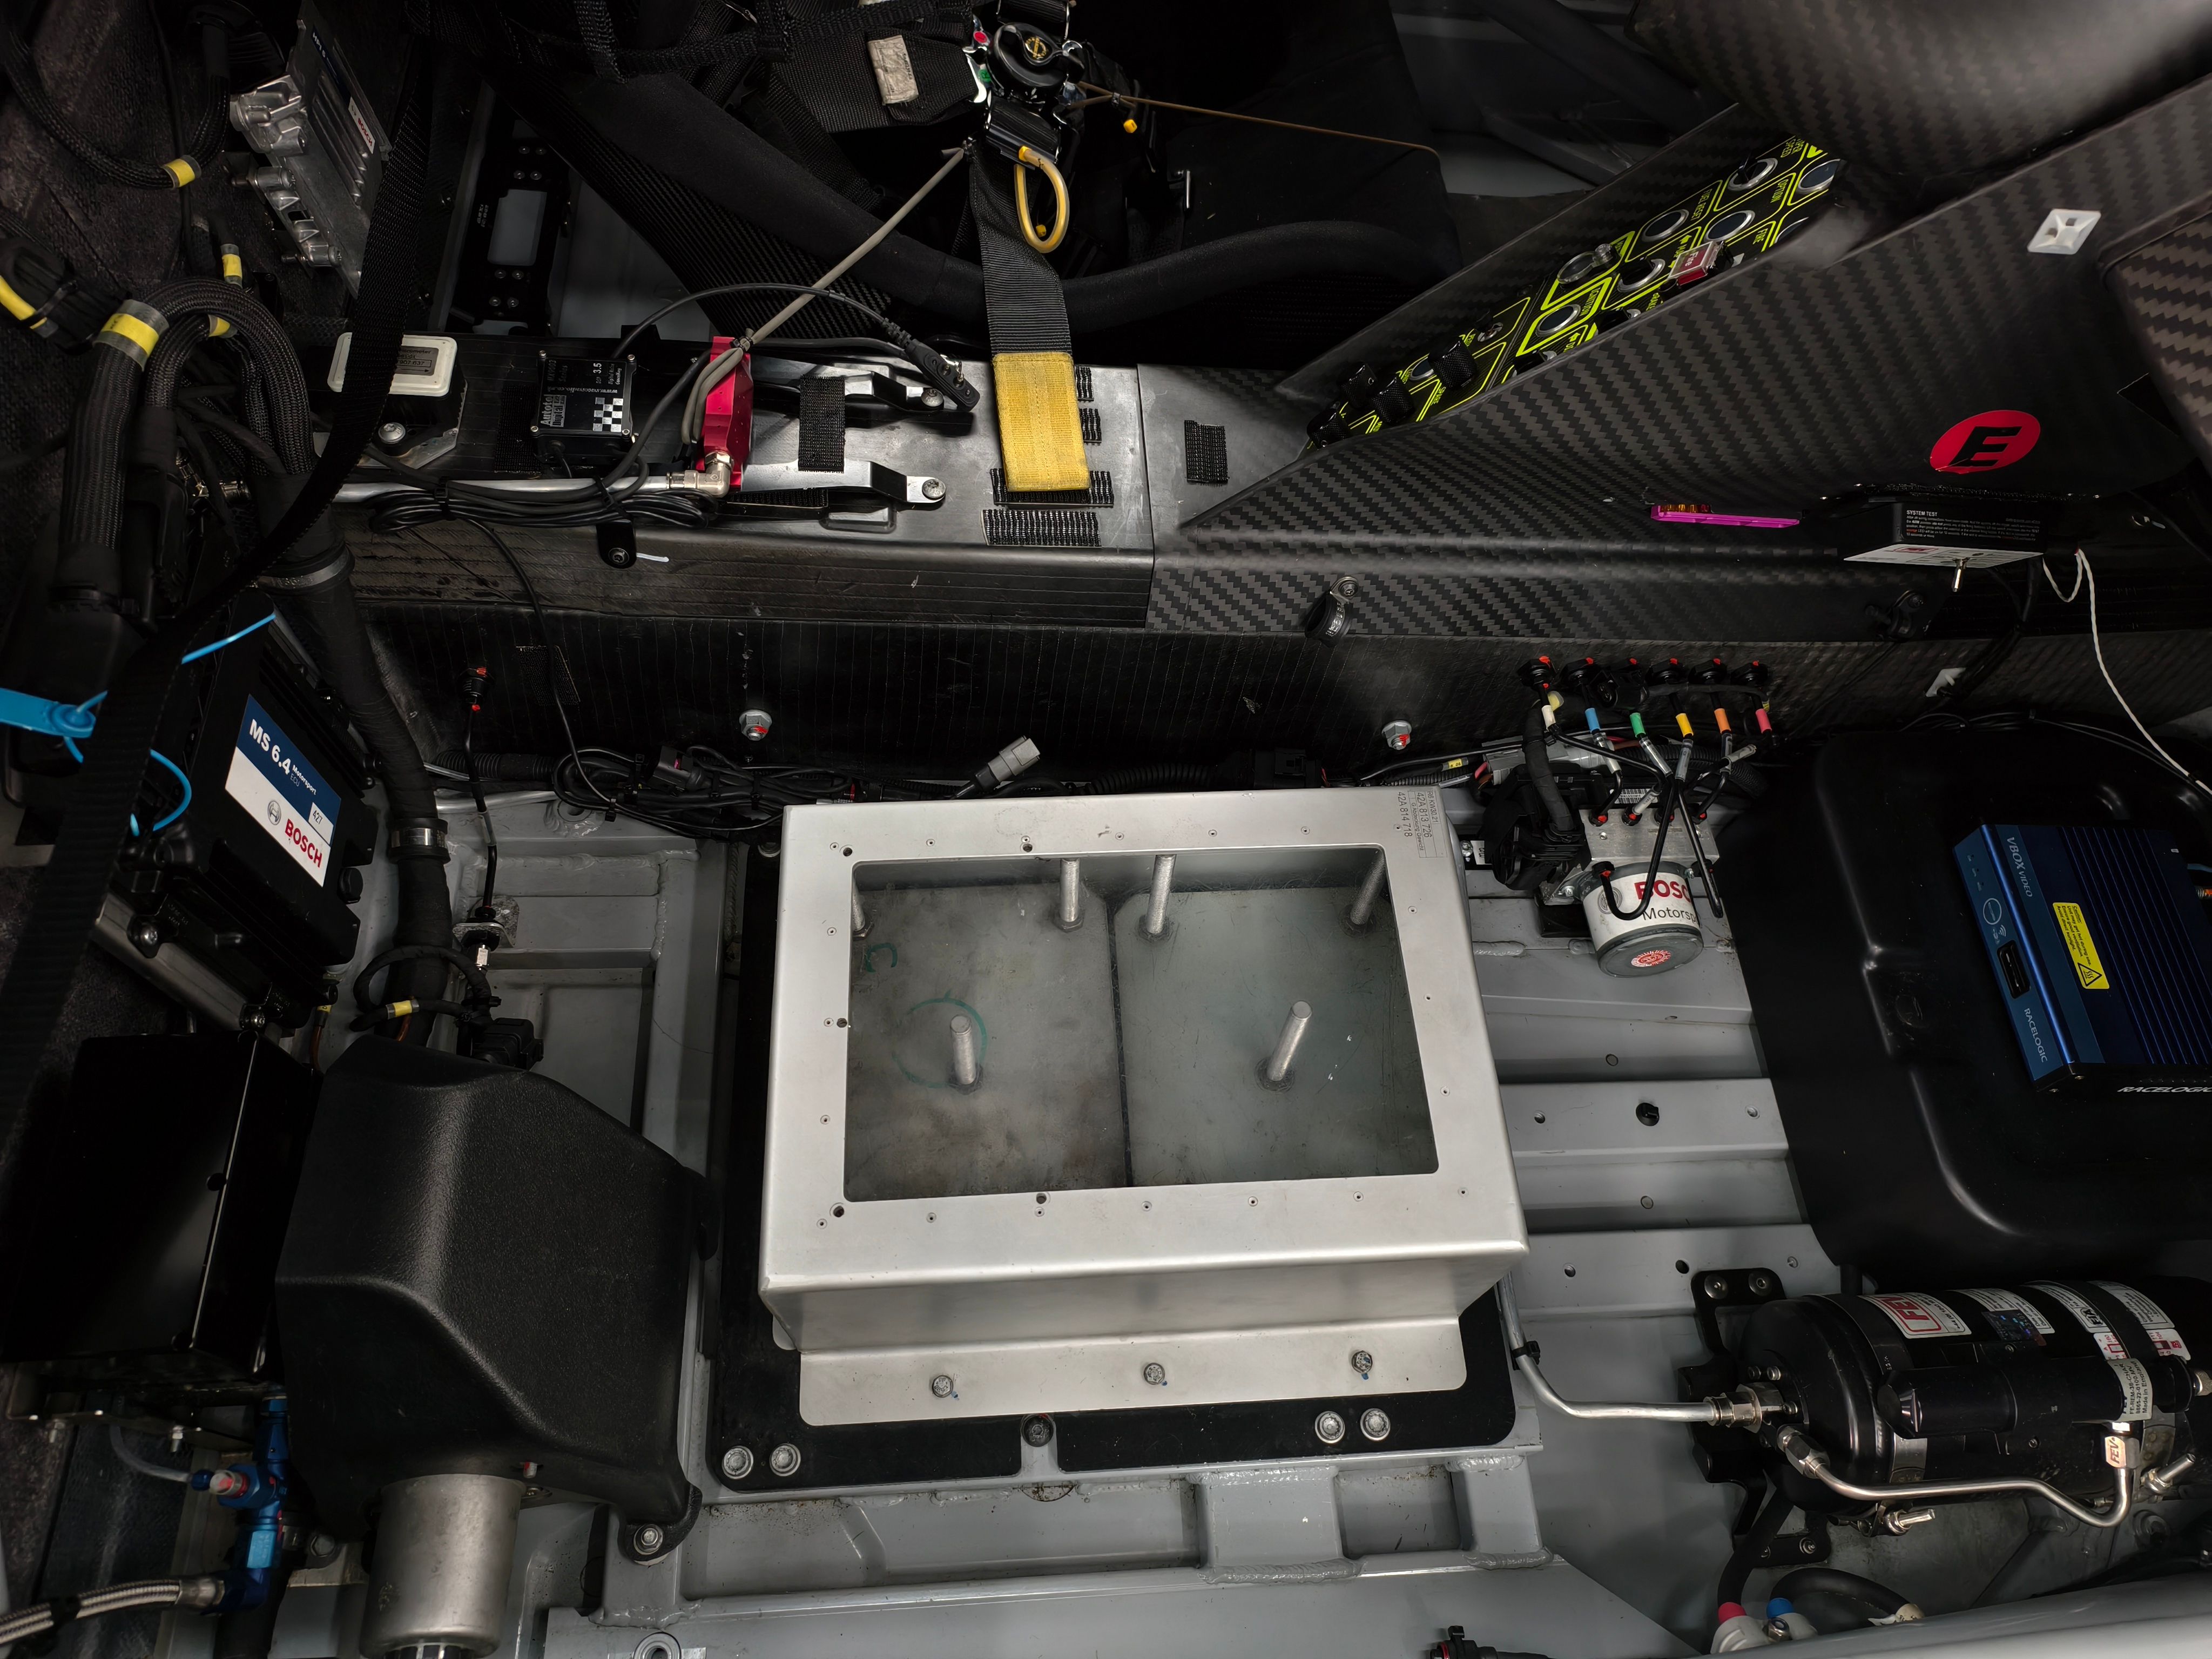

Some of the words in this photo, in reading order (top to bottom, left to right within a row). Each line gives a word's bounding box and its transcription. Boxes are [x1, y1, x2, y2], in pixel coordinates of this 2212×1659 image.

[358, 118, 373, 146] BOSCH
[1770, 179, 1789, 204] OPTION
[1690, 201, 1707, 221] RESET
[1752, 228, 1768, 245] FIRE
[1684, 251, 1700, 266] Fire
[1580, 287, 1602, 316] IGNITION
[593, 362, 602, 374] 3.5
[552, 406, 564, 426] Digital
[1948, 426, 2023, 467] E
[249, 719, 271, 752] MS
[272, 745, 291, 775] 6.4
[292, 764, 317, 795] Motorsport
[290, 773, 300, 787] ECU
[1398, 792, 1407, 806] 42A
[1417, 792, 1426, 807] 42A
[312, 810, 323, 825] 427
[1400, 807, 1410, 821] 814
[1419, 808, 1429, 821] 813
[1403, 823, 1413, 837] 718
[1422, 824, 1432, 838] 726
[285, 819, 323, 868] BOSCH
[2007, 837, 2026, 870] VBOX
[2019, 871, 2033, 897] VIDEO
[1634, 880, 1691, 903] BOSC
[2067, 921, 2075, 933] good
[2024, 1008, 2048, 1063] RACELOGIC
[1874, 1297, 1931, 1320] FEV
[2083, 1309, 2102, 1325] FIA
[2130, 1361, 2147, 1387] England
[2110, 1439, 2119, 1464] FEV
